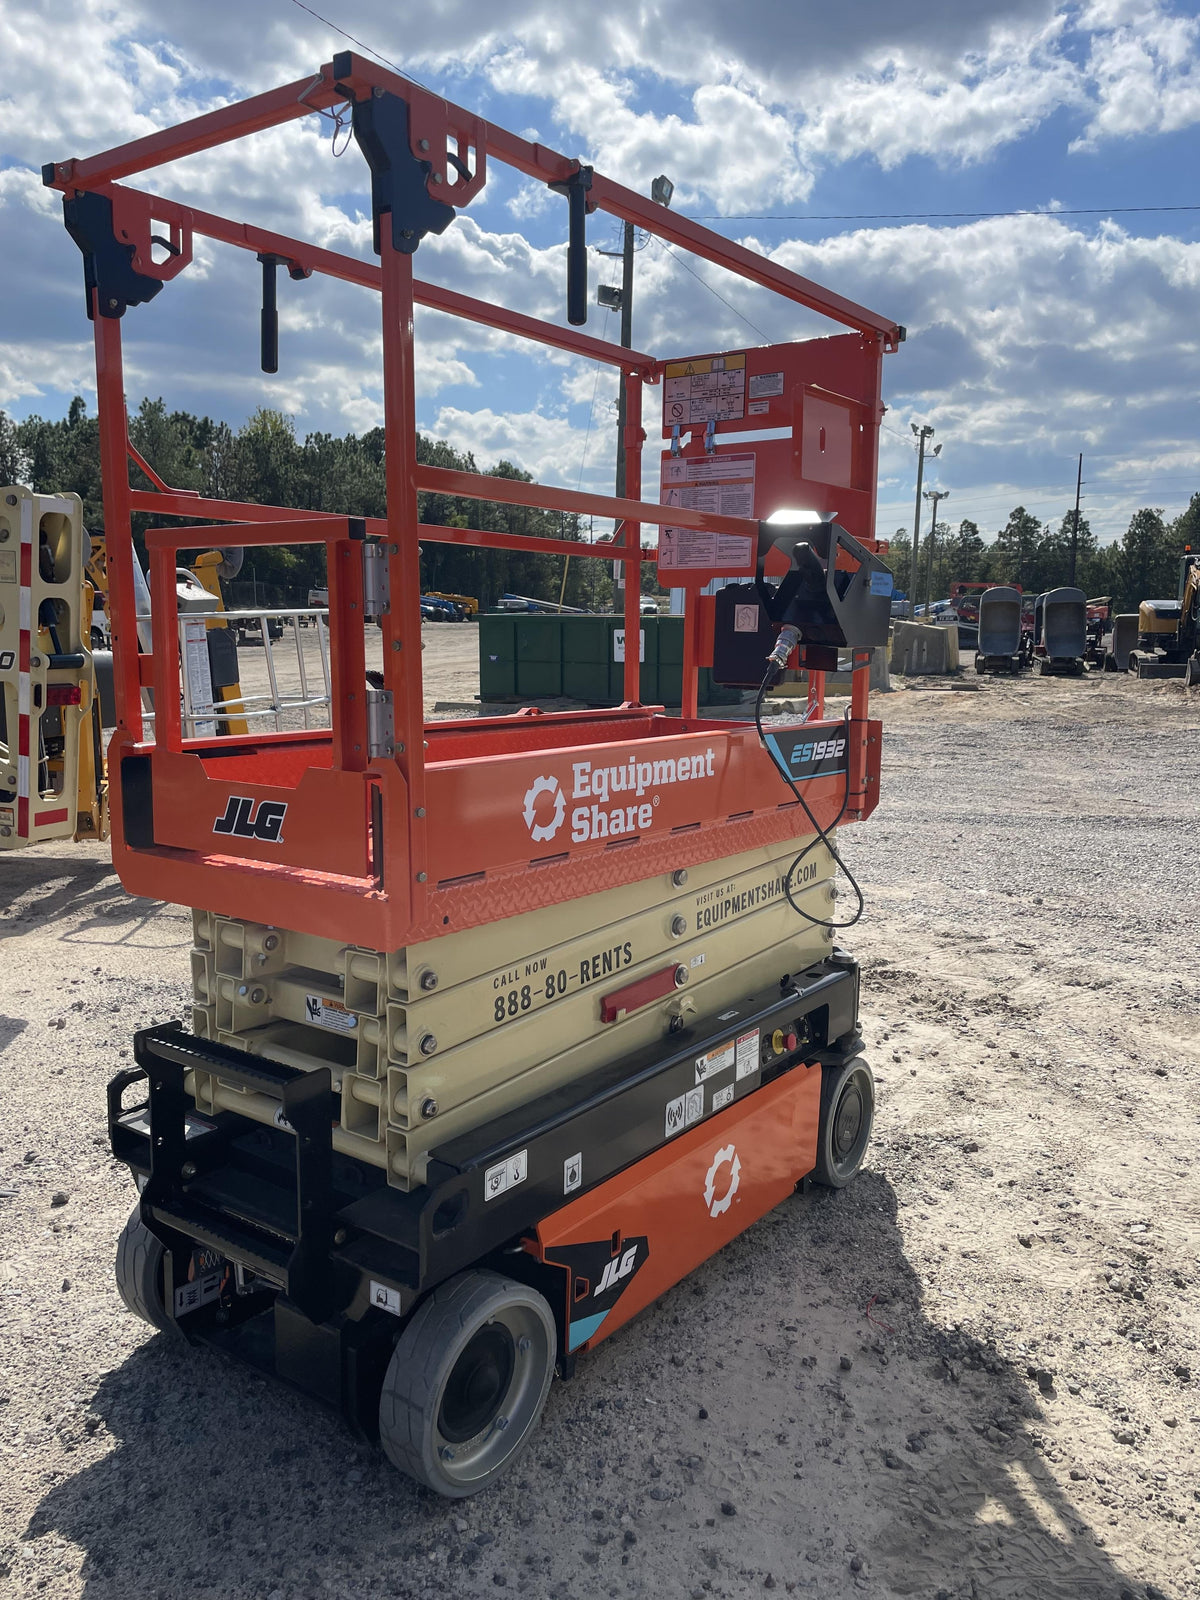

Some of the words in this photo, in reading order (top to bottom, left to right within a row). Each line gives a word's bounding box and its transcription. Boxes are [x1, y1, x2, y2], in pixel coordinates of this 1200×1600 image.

[790, 738, 846, 764] ES1932
[572, 748, 715, 803] Equipment
[212, 795, 288, 843] JLG
[696, 892, 713, 906] VISIT
[715, 887, 724, 899] US
[493, 969, 520, 990] CALL
[525, 957, 548, 977] NOW
[494, 941, 632, 1022] 888-80-RENTS
[593, 1244, 638, 1297] JLG
